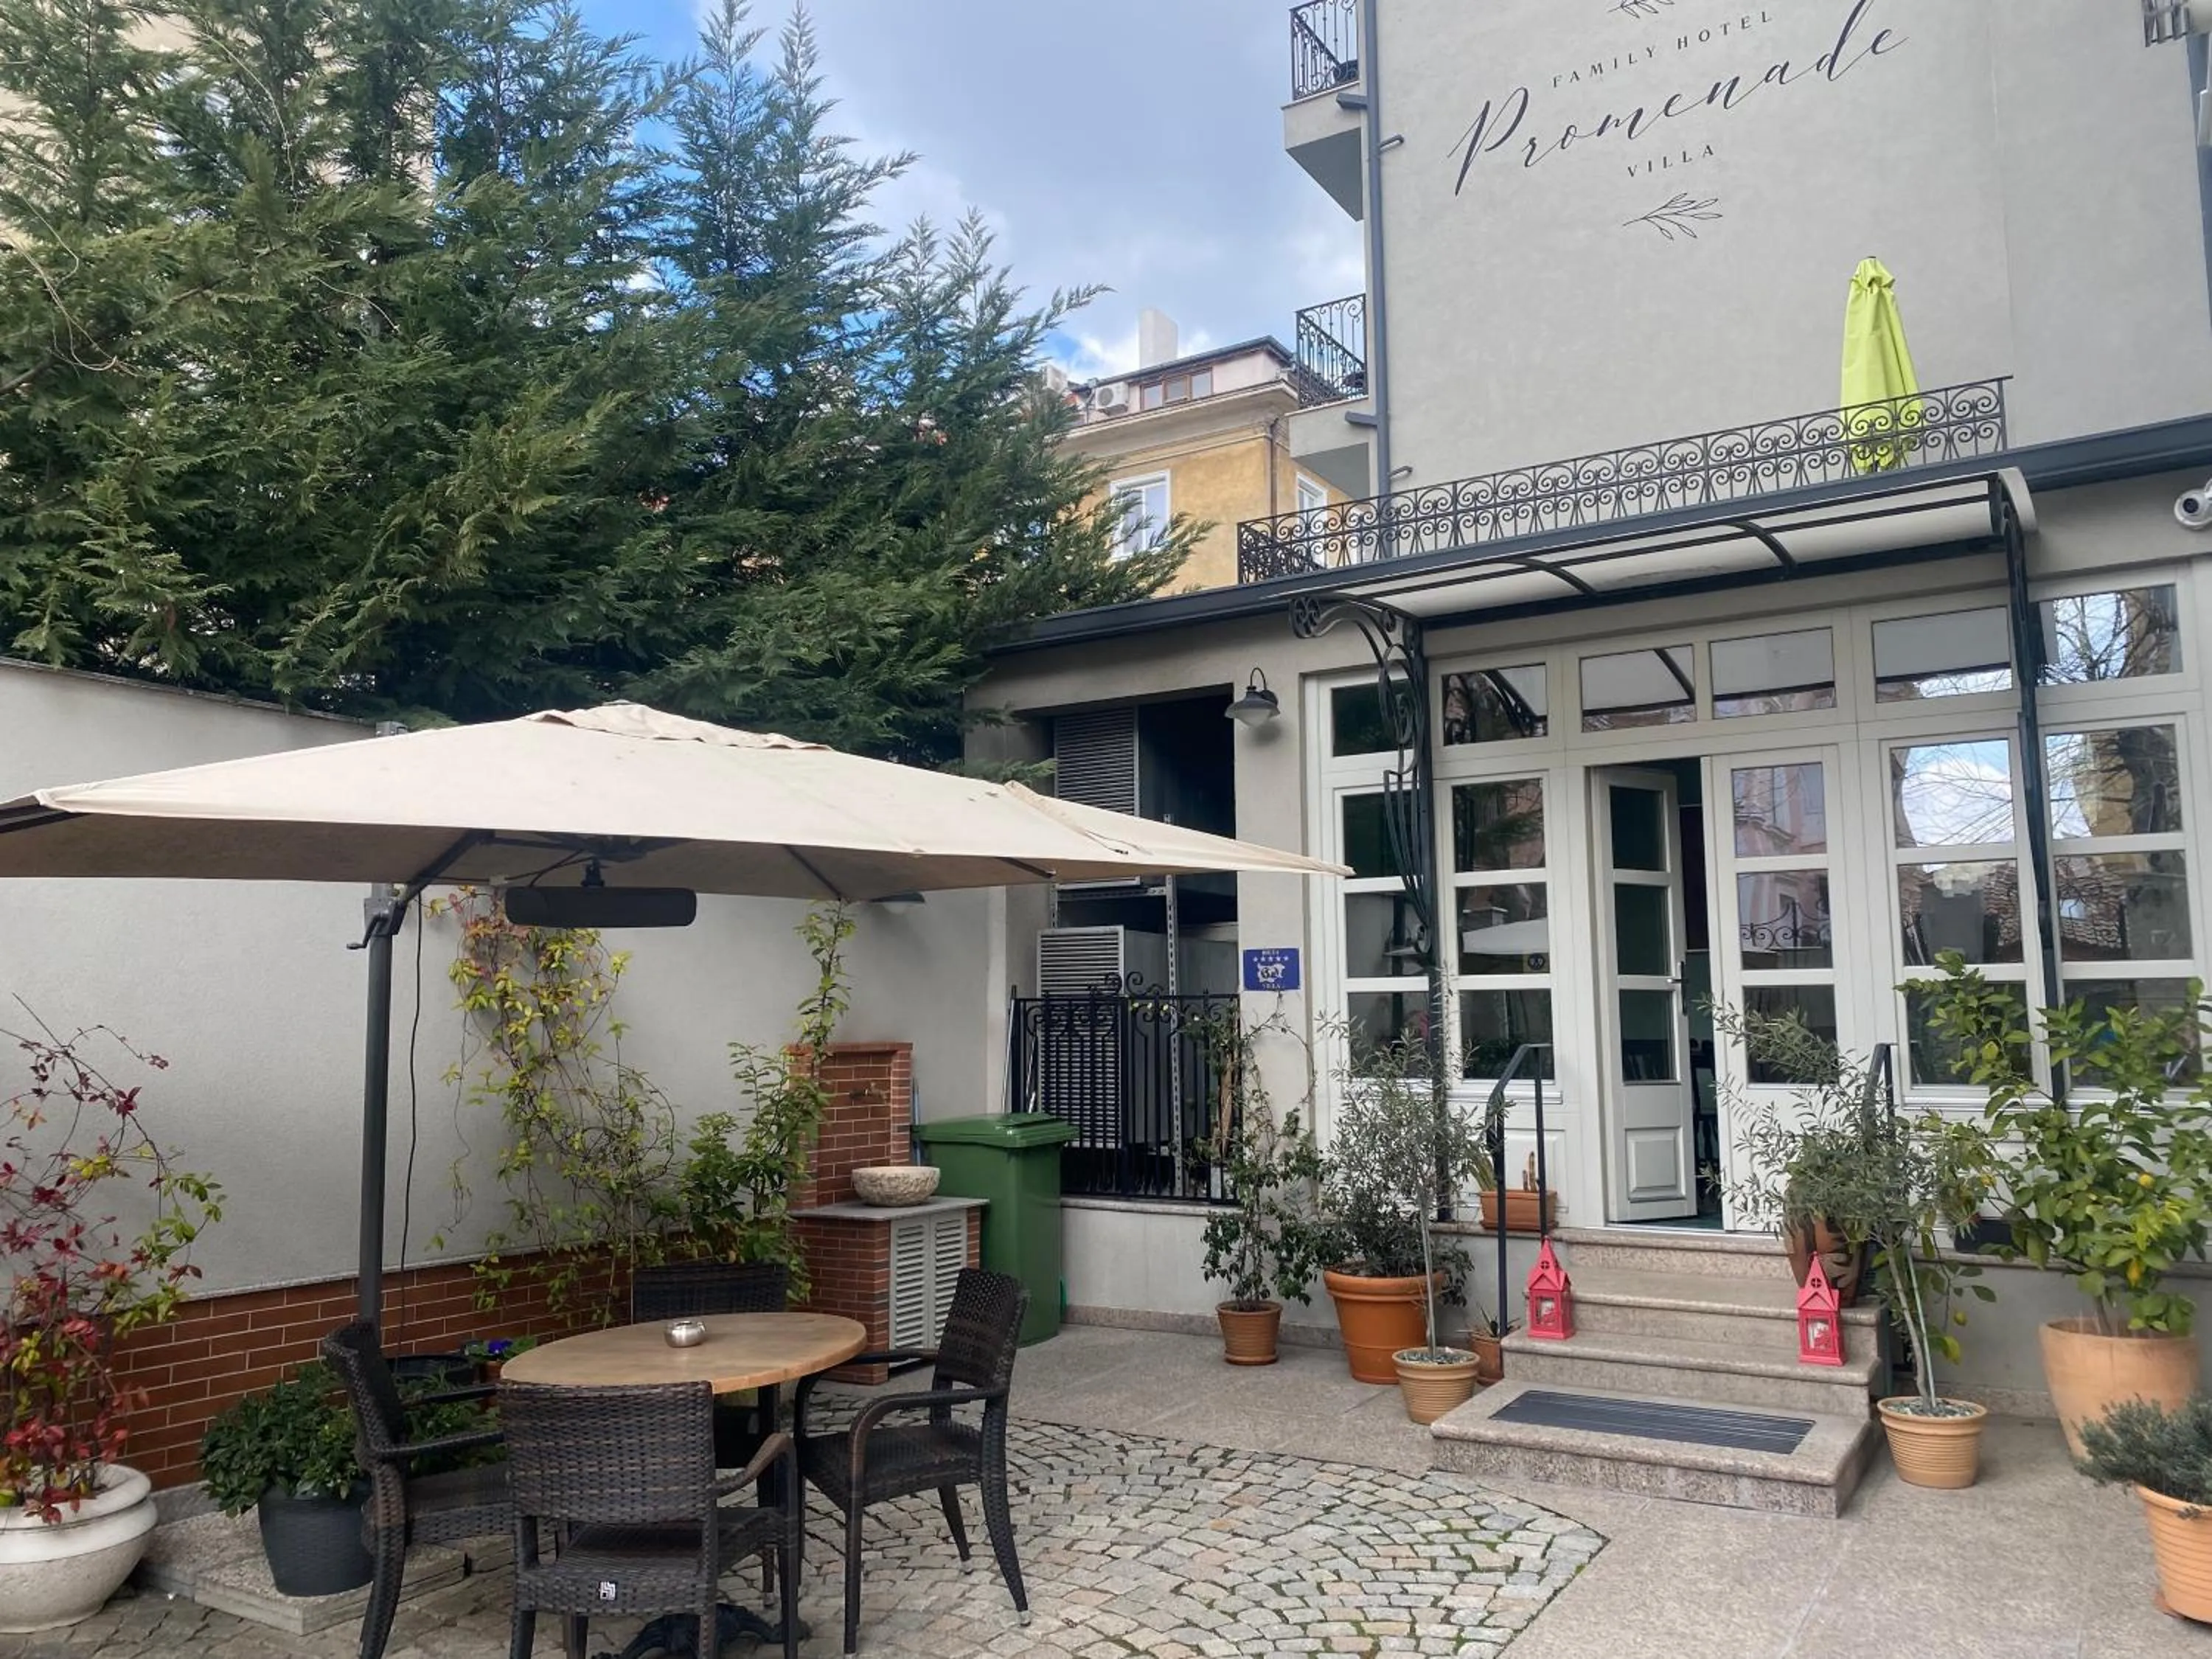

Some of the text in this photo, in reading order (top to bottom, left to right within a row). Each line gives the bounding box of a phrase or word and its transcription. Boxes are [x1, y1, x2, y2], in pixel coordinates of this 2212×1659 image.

[1552, 11, 1773, 88] FAMILY HOTEL
[1447, 0, 1909, 197] Promenade
[1627, 144, 1714, 178] VILLA
